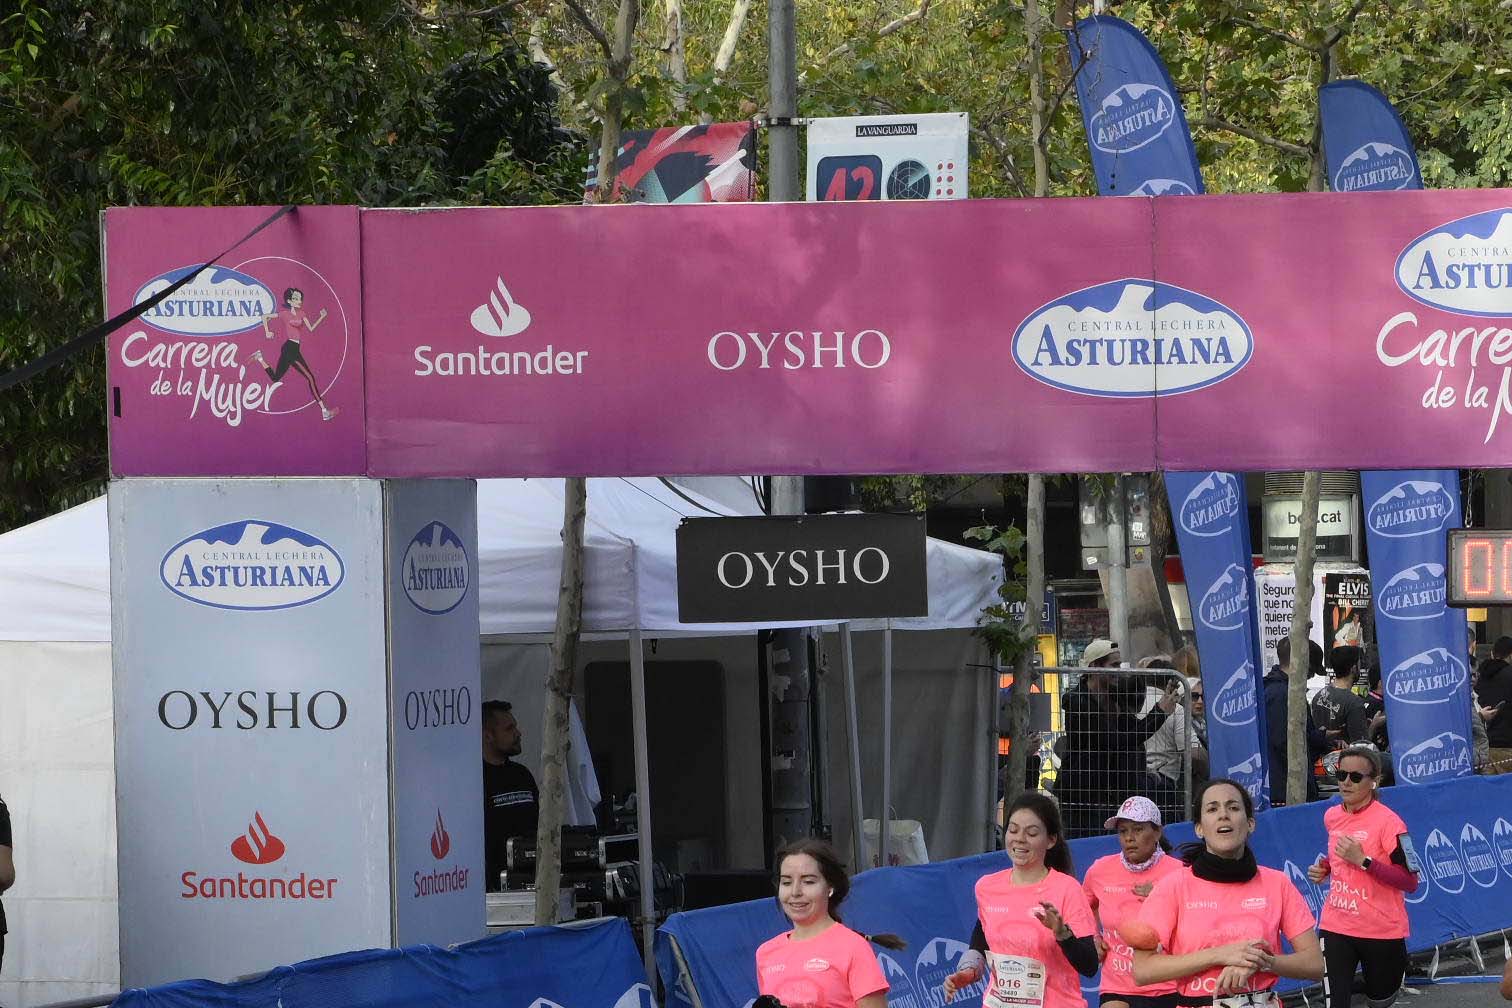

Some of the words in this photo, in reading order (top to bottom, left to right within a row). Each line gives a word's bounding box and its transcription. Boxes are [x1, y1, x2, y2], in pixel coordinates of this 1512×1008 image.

[867, 125, 916, 135] VANGUARDIA
[144, 291, 265, 318] ASTURIANA
[1068, 319, 1142, 333] CENTRAL
[1150, 319, 1226, 332] LECHERA
[121, 331, 239, 368] Carrera
[414, 344, 588, 376] Santander
[707, 329, 891, 371] OYSHO
[1030, 324, 1235, 368] ASTURIANA
[150, 370, 172, 396] de
[177, 371, 192, 395] la
[190, 365, 284, 427] Mujer
[1422, 371, 1456, 409] de
[1464, 370, 1488, 408] la
[175, 554, 331, 588] ASTURIANA
[203, 551, 261, 560] CENTRAL
[266, 551, 325, 560] LECHERA
[717, 547, 890, 590] OYSHO
[407, 557, 465, 592] ASTURIANA
[1338, 582, 1369, 595] ELVIS
[1264, 599, 1280, 610] que
[158, 690, 347, 731] OYSHO
[405, 686, 471, 731] OYSHO
[181, 871, 337, 899] Santander
[414, 866, 468, 899] Santander
[999, 979, 1021, 988] 016
